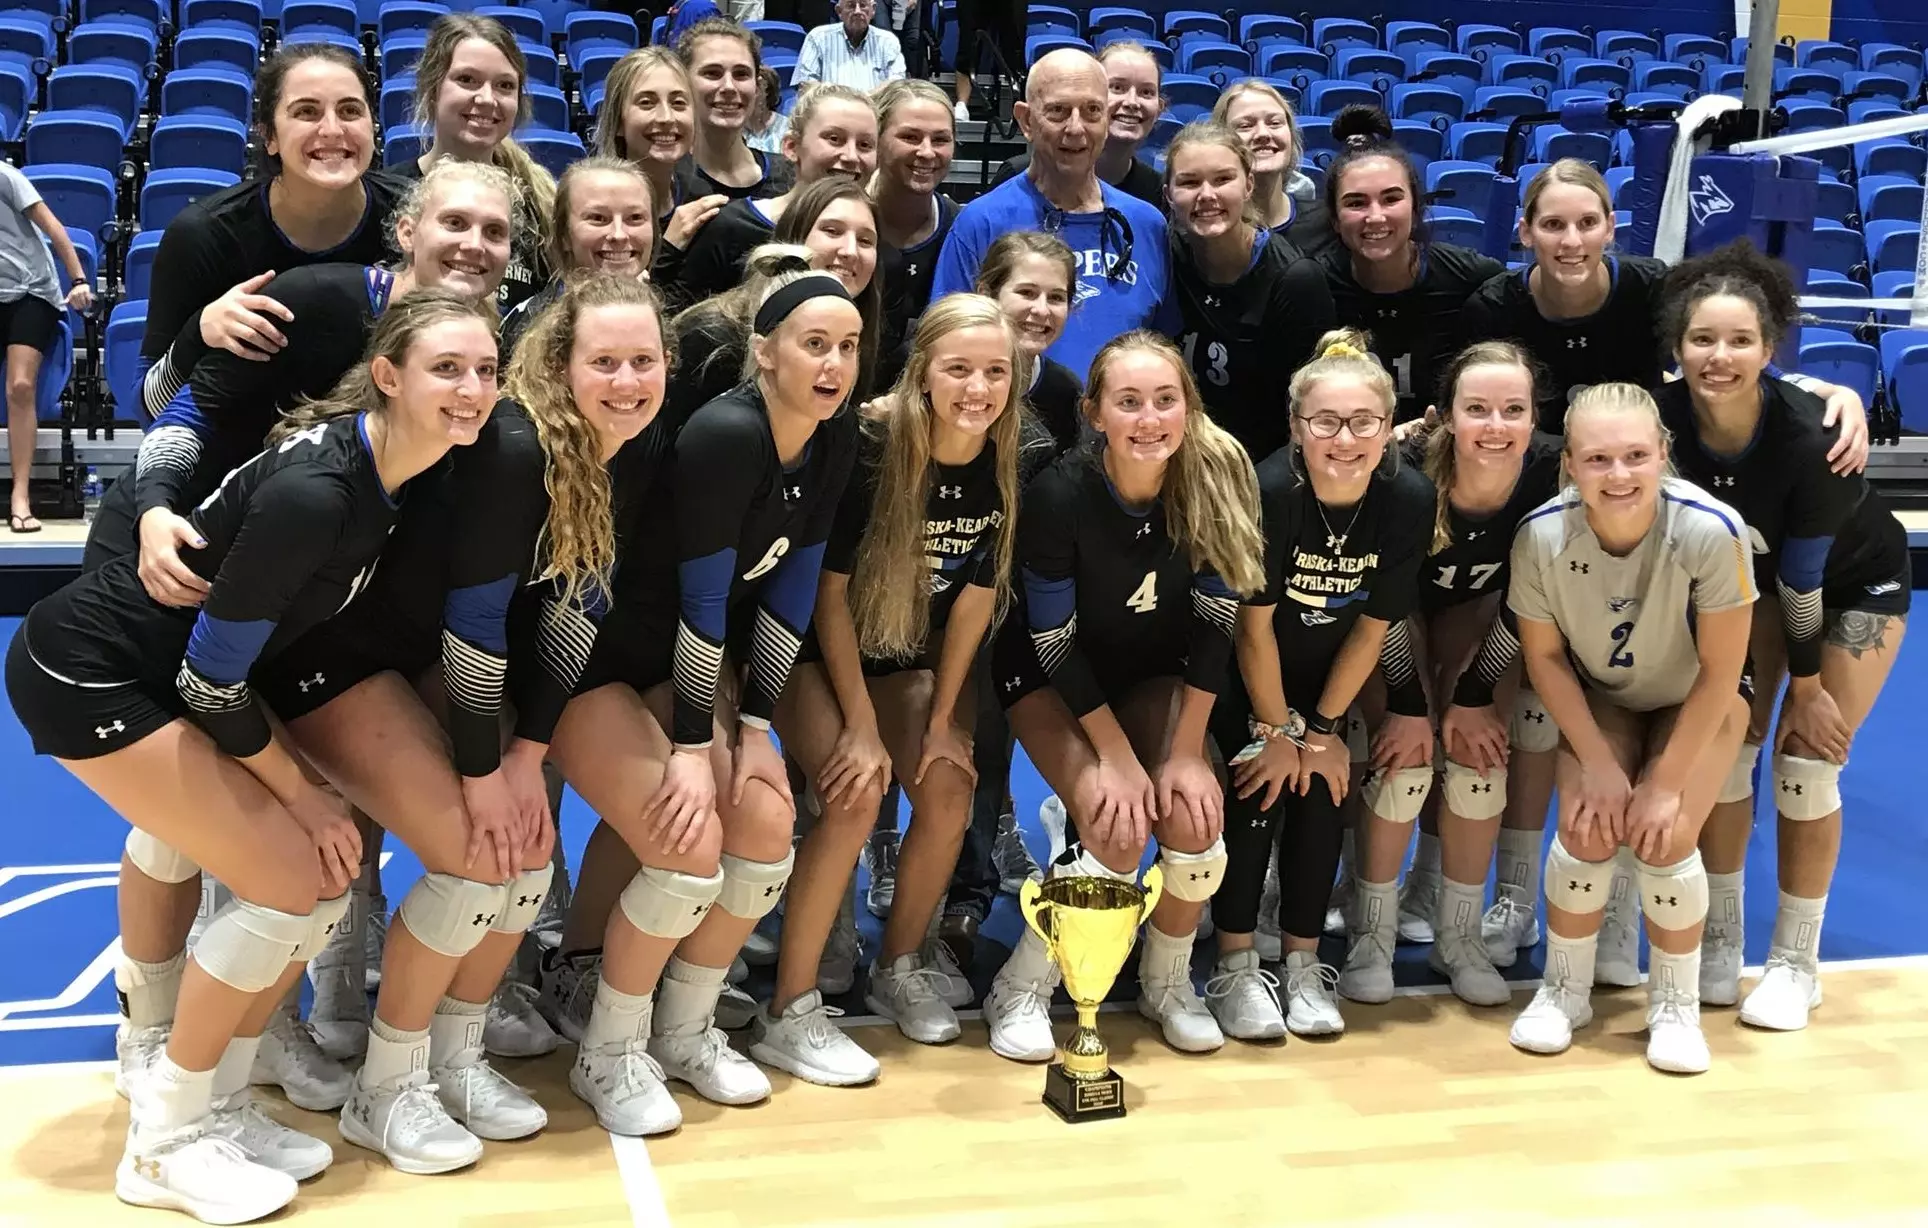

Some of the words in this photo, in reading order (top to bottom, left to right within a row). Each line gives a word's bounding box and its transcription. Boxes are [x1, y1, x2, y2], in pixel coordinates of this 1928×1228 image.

[1126, 571, 1158, 613] 4
[1291, 573, 1363, 593] ATHLETIC
[1432, 562, 1503, 590] 17
[1608, 621, 1635, 669] 2
